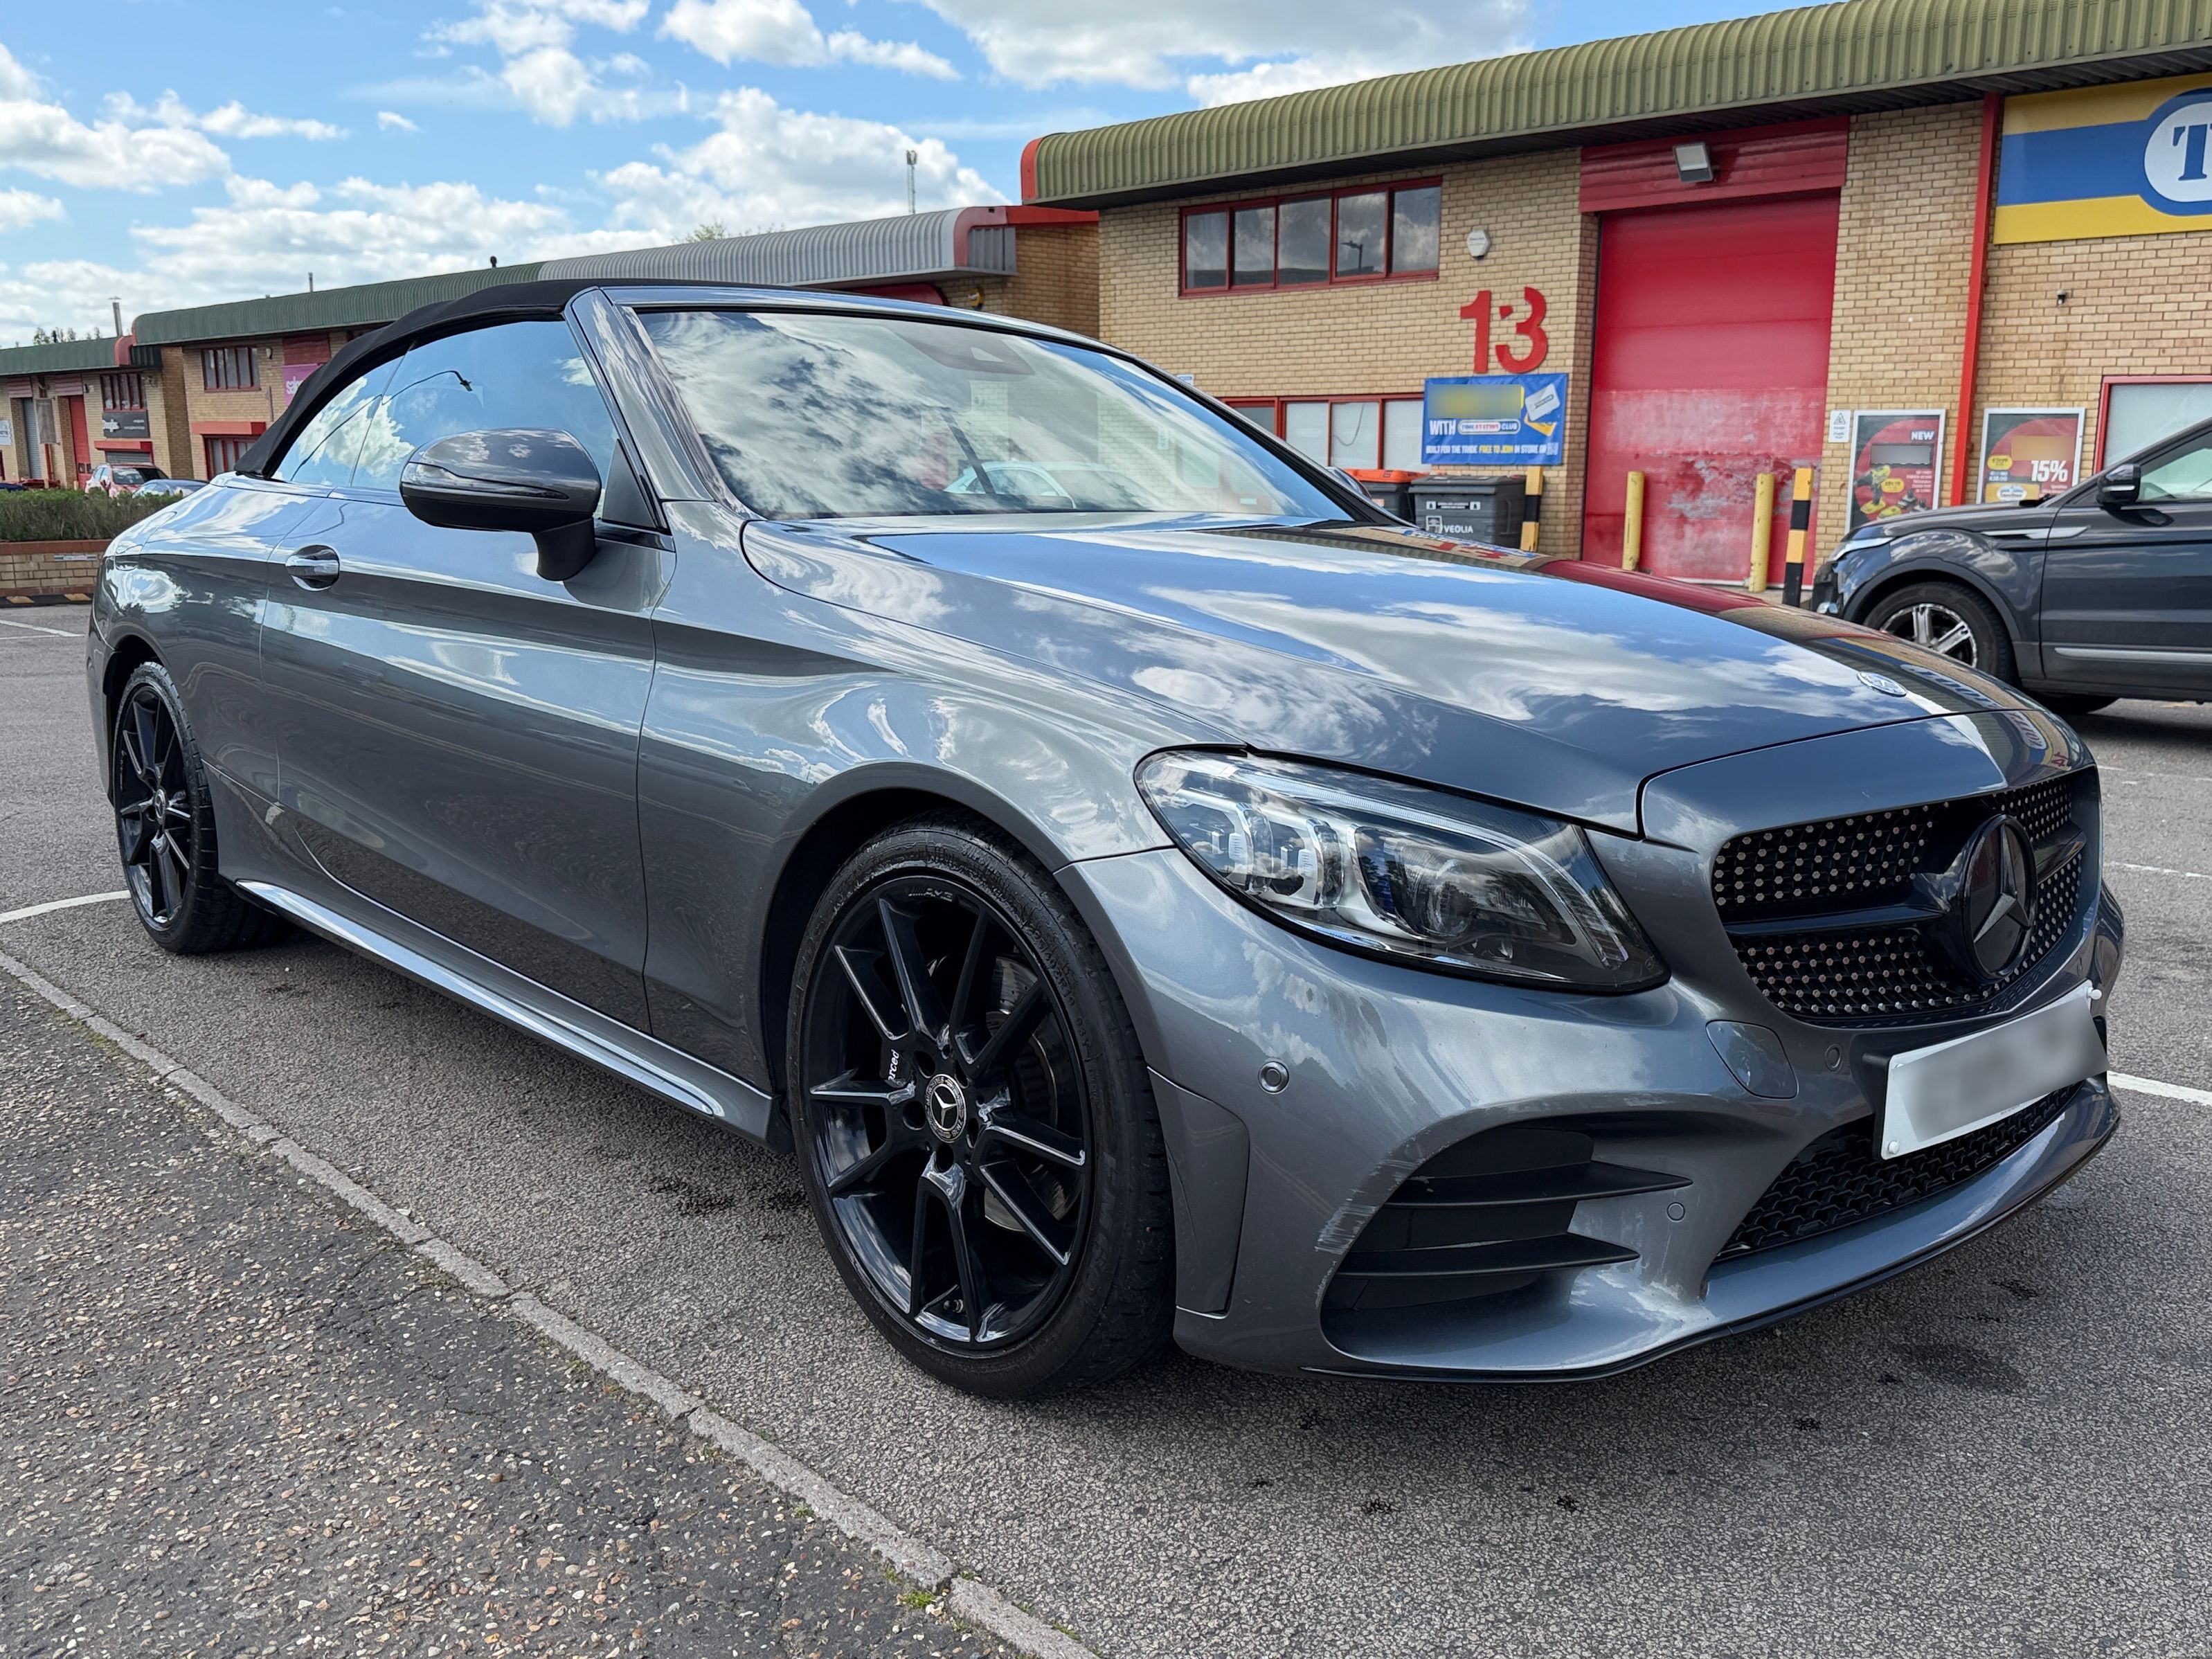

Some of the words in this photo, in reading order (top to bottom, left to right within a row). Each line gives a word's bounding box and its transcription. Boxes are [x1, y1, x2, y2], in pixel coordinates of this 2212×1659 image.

[2173, 123, 2212, 181] T
[1460, 287, 1549, 374] 13
[1429, 420, 1456, 436] WITH
[1911, 431, 1934, 440] NEW
[2031, 460, 2068, 482] 15%
[1444, 525, 1473, 533] VEOLIA
